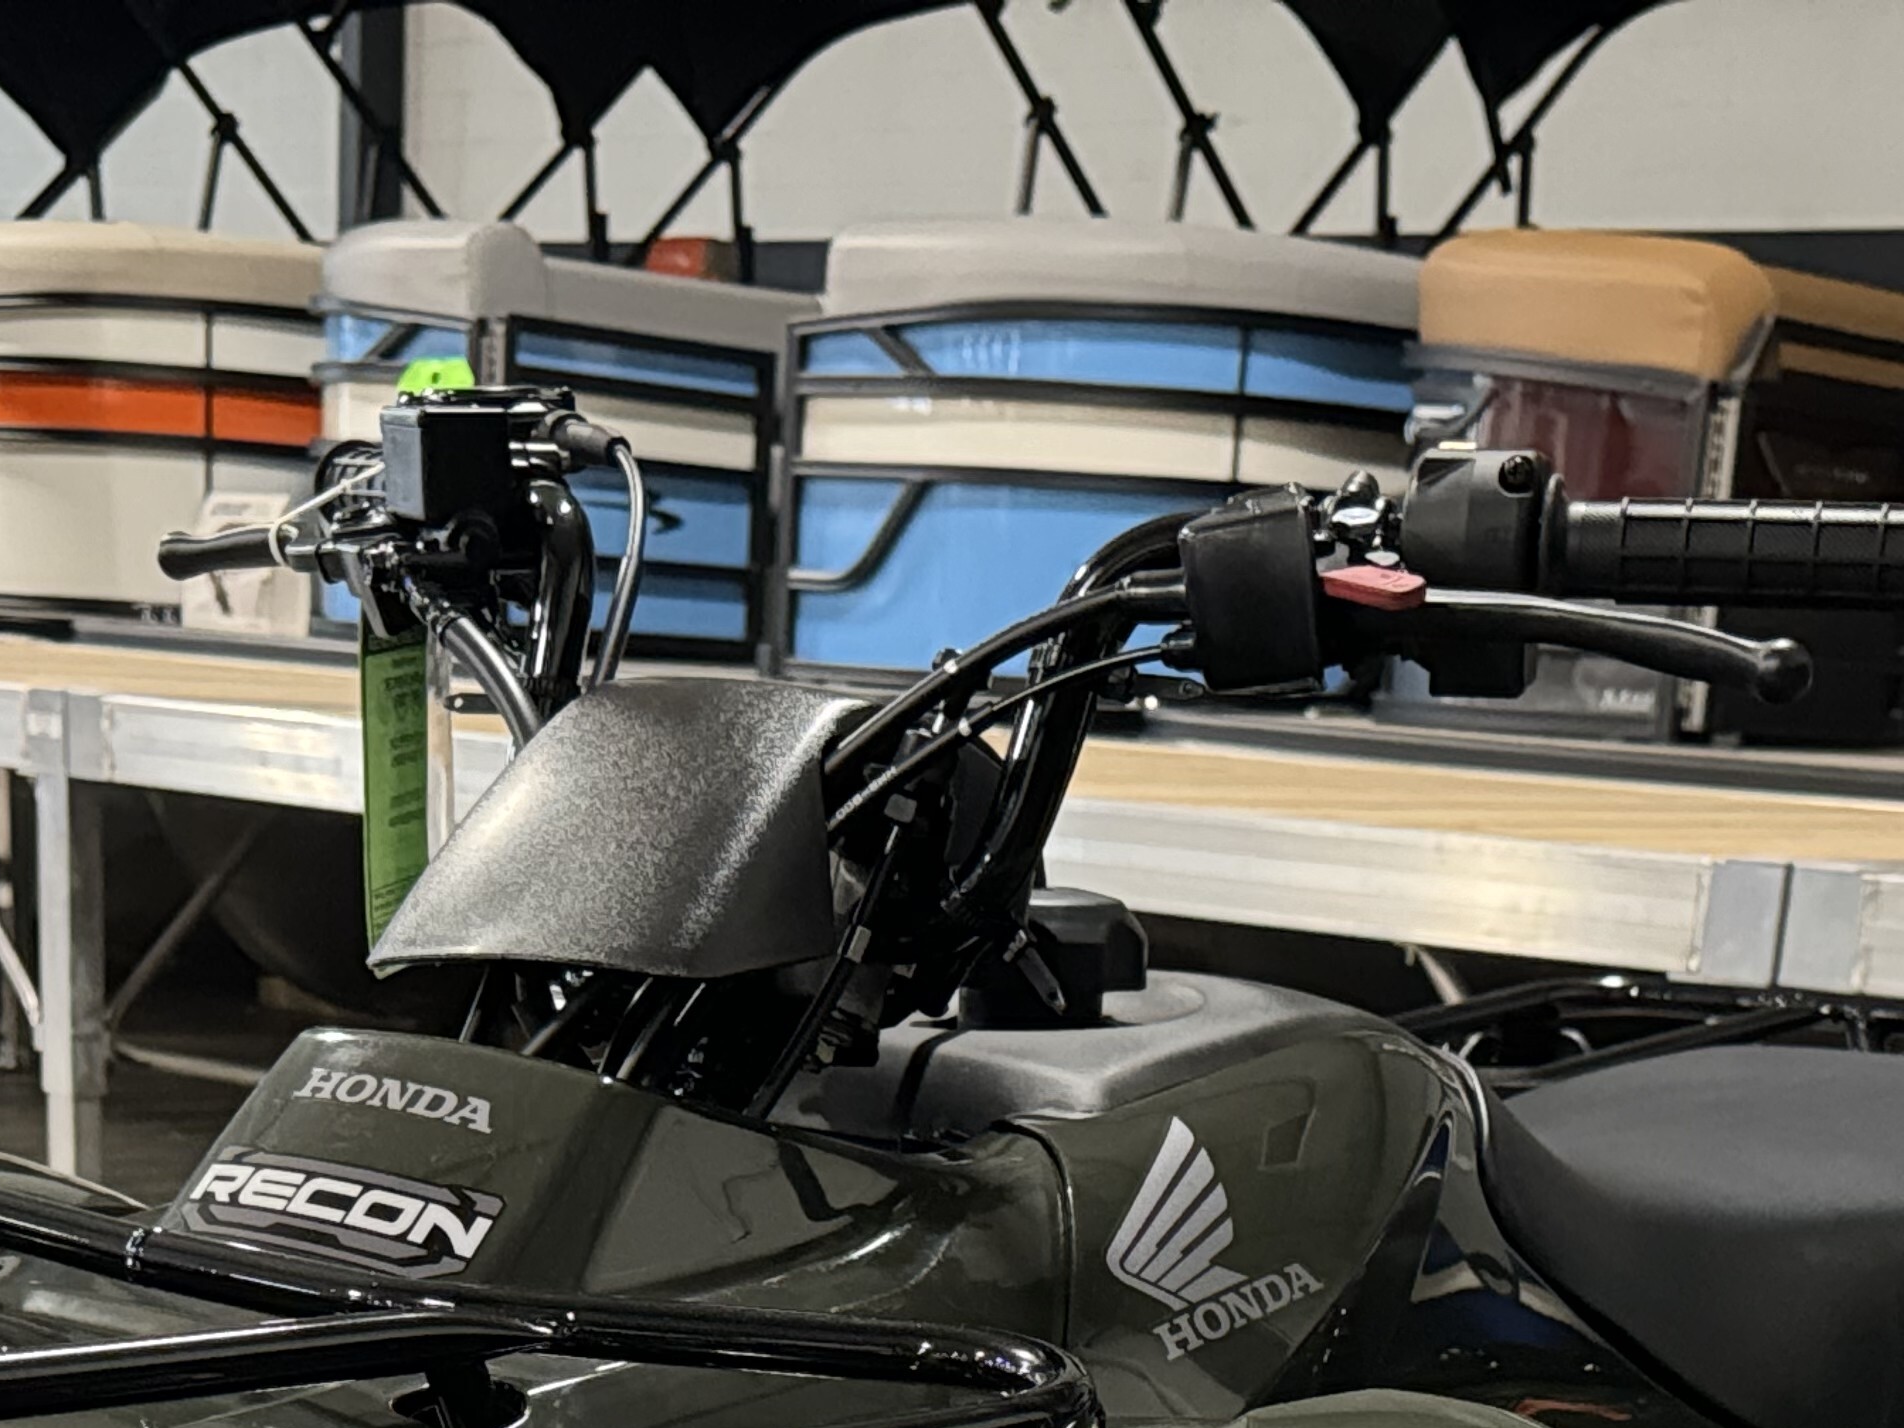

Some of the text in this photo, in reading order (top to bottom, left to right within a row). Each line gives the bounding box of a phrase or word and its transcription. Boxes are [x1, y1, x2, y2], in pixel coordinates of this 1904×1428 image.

[293, 1066, 494, 1135] HONDA
[190, 1161, 496, 1260] RECON
[1151, 1262, 1324, 1363] HONDA
